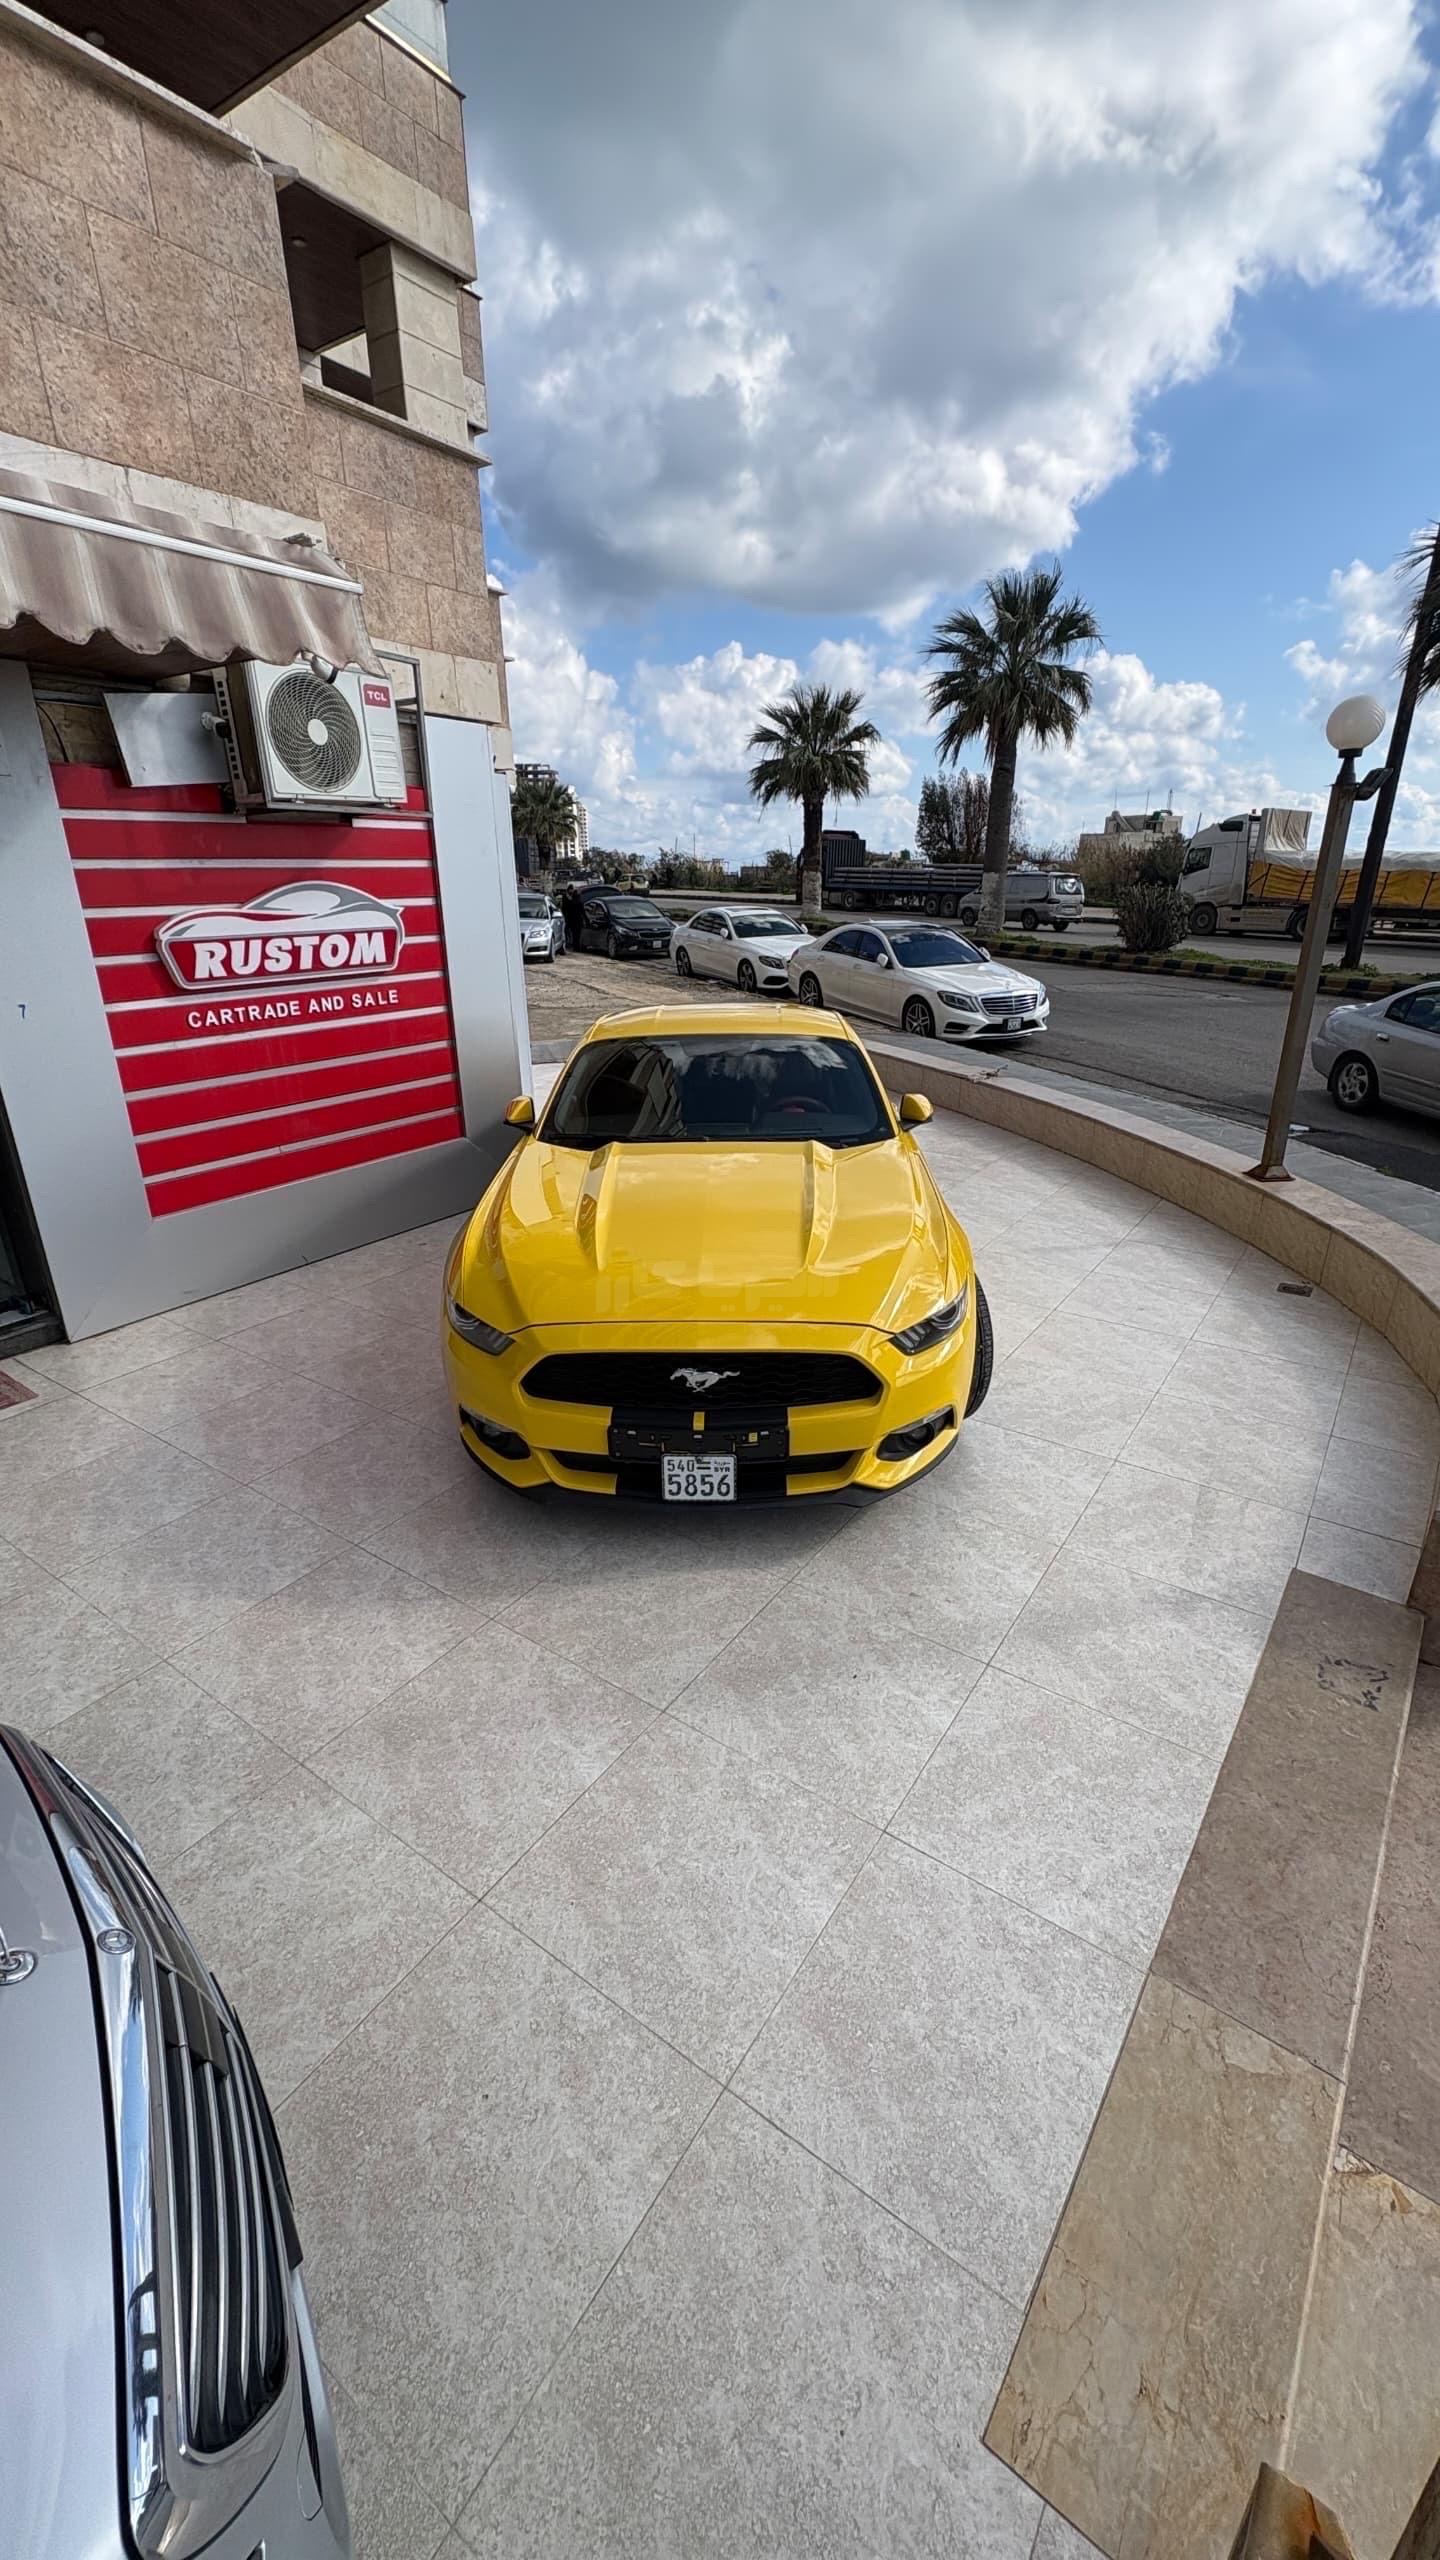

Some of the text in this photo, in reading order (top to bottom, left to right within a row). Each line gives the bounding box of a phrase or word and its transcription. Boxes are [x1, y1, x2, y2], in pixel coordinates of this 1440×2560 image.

[367, 690, 387, 701] TCL
[193, 931, 387, 979] RUSTOM
[187, 989, 399, 1028] CARTRADE AND SALE
[667, 1459, 695, 1472] 540
[667, 1474, 731, 1497] 5856
